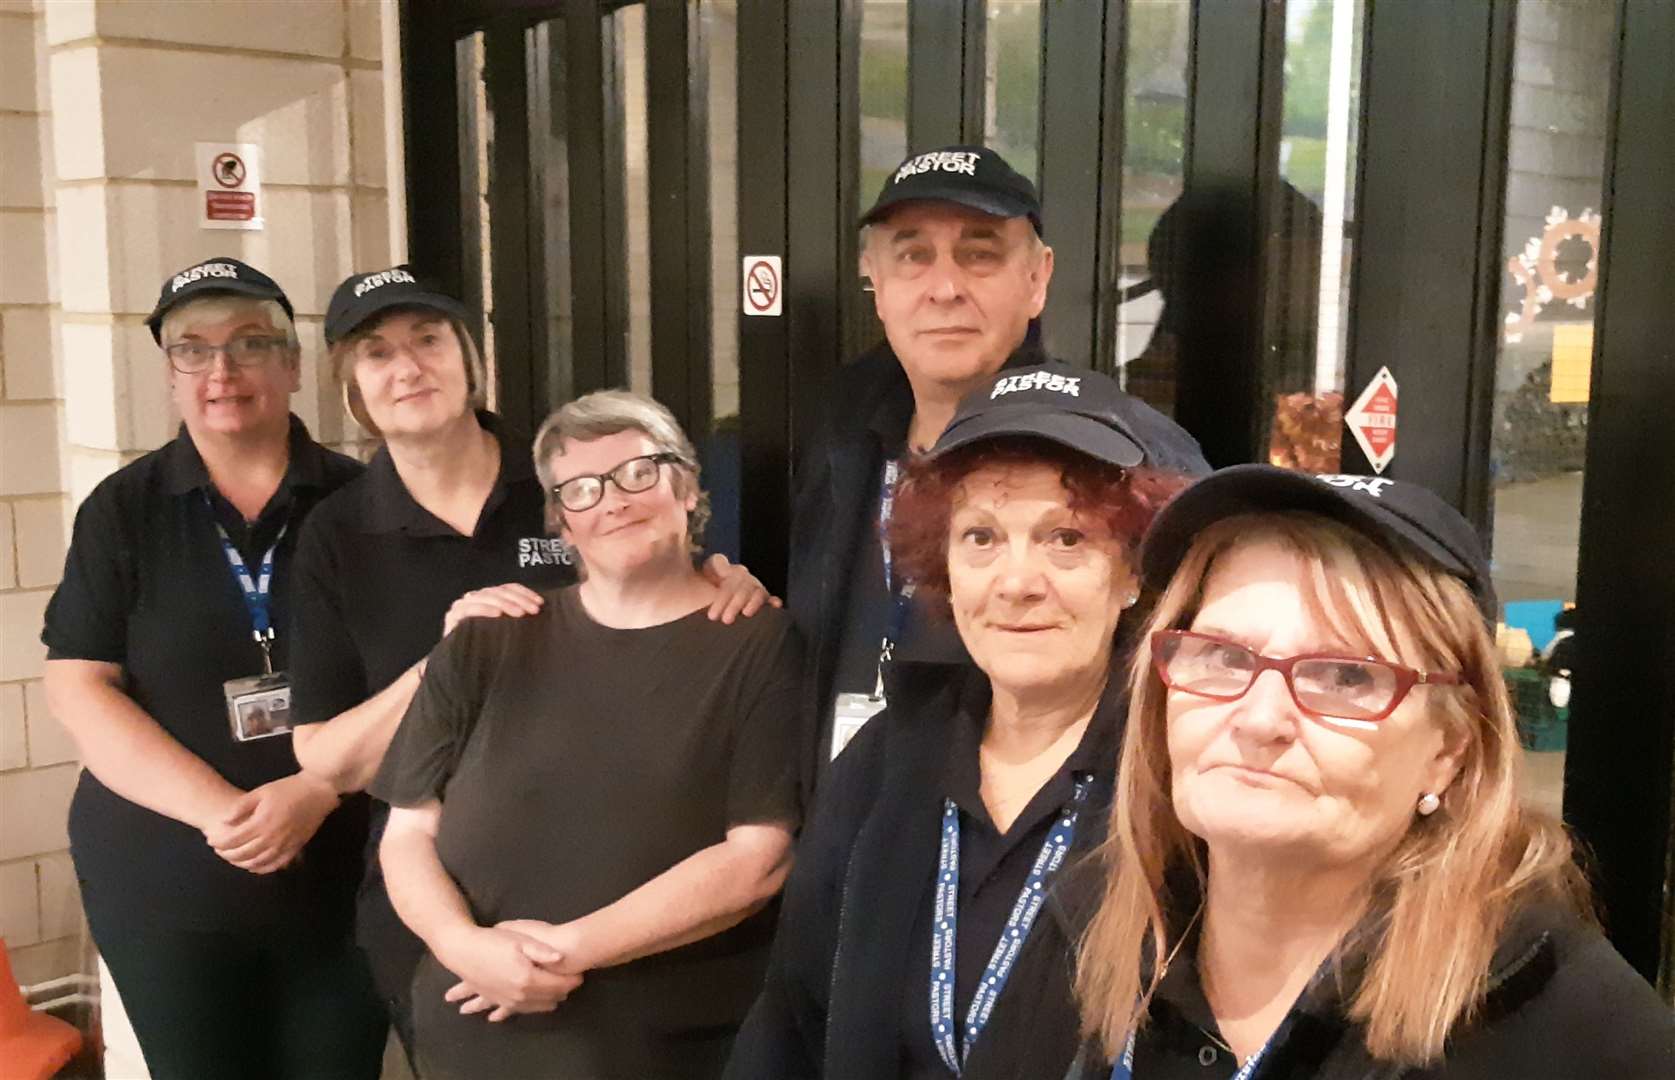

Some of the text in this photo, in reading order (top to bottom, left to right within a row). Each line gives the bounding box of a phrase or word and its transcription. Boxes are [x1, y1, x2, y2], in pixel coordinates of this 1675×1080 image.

[894, 160, 975, 185] PASTOR
[990, 380, 1080, 400] PASTOR
[994, 371, 1081, 392] STREET
[519, 550, 573, 568] PASTO
[1033, 841, 1054, 876] STREET
[1008, 886, 1033, 928] PASTORS
[1021, 894, 1042, 930] STREET
[943, 928, 953, 970] PASTORS
[987, 935, 1009, 970] STREET
[997, 937, 1021, 978] PASTORS
[966, 982, 989, 1024] PASTORS
